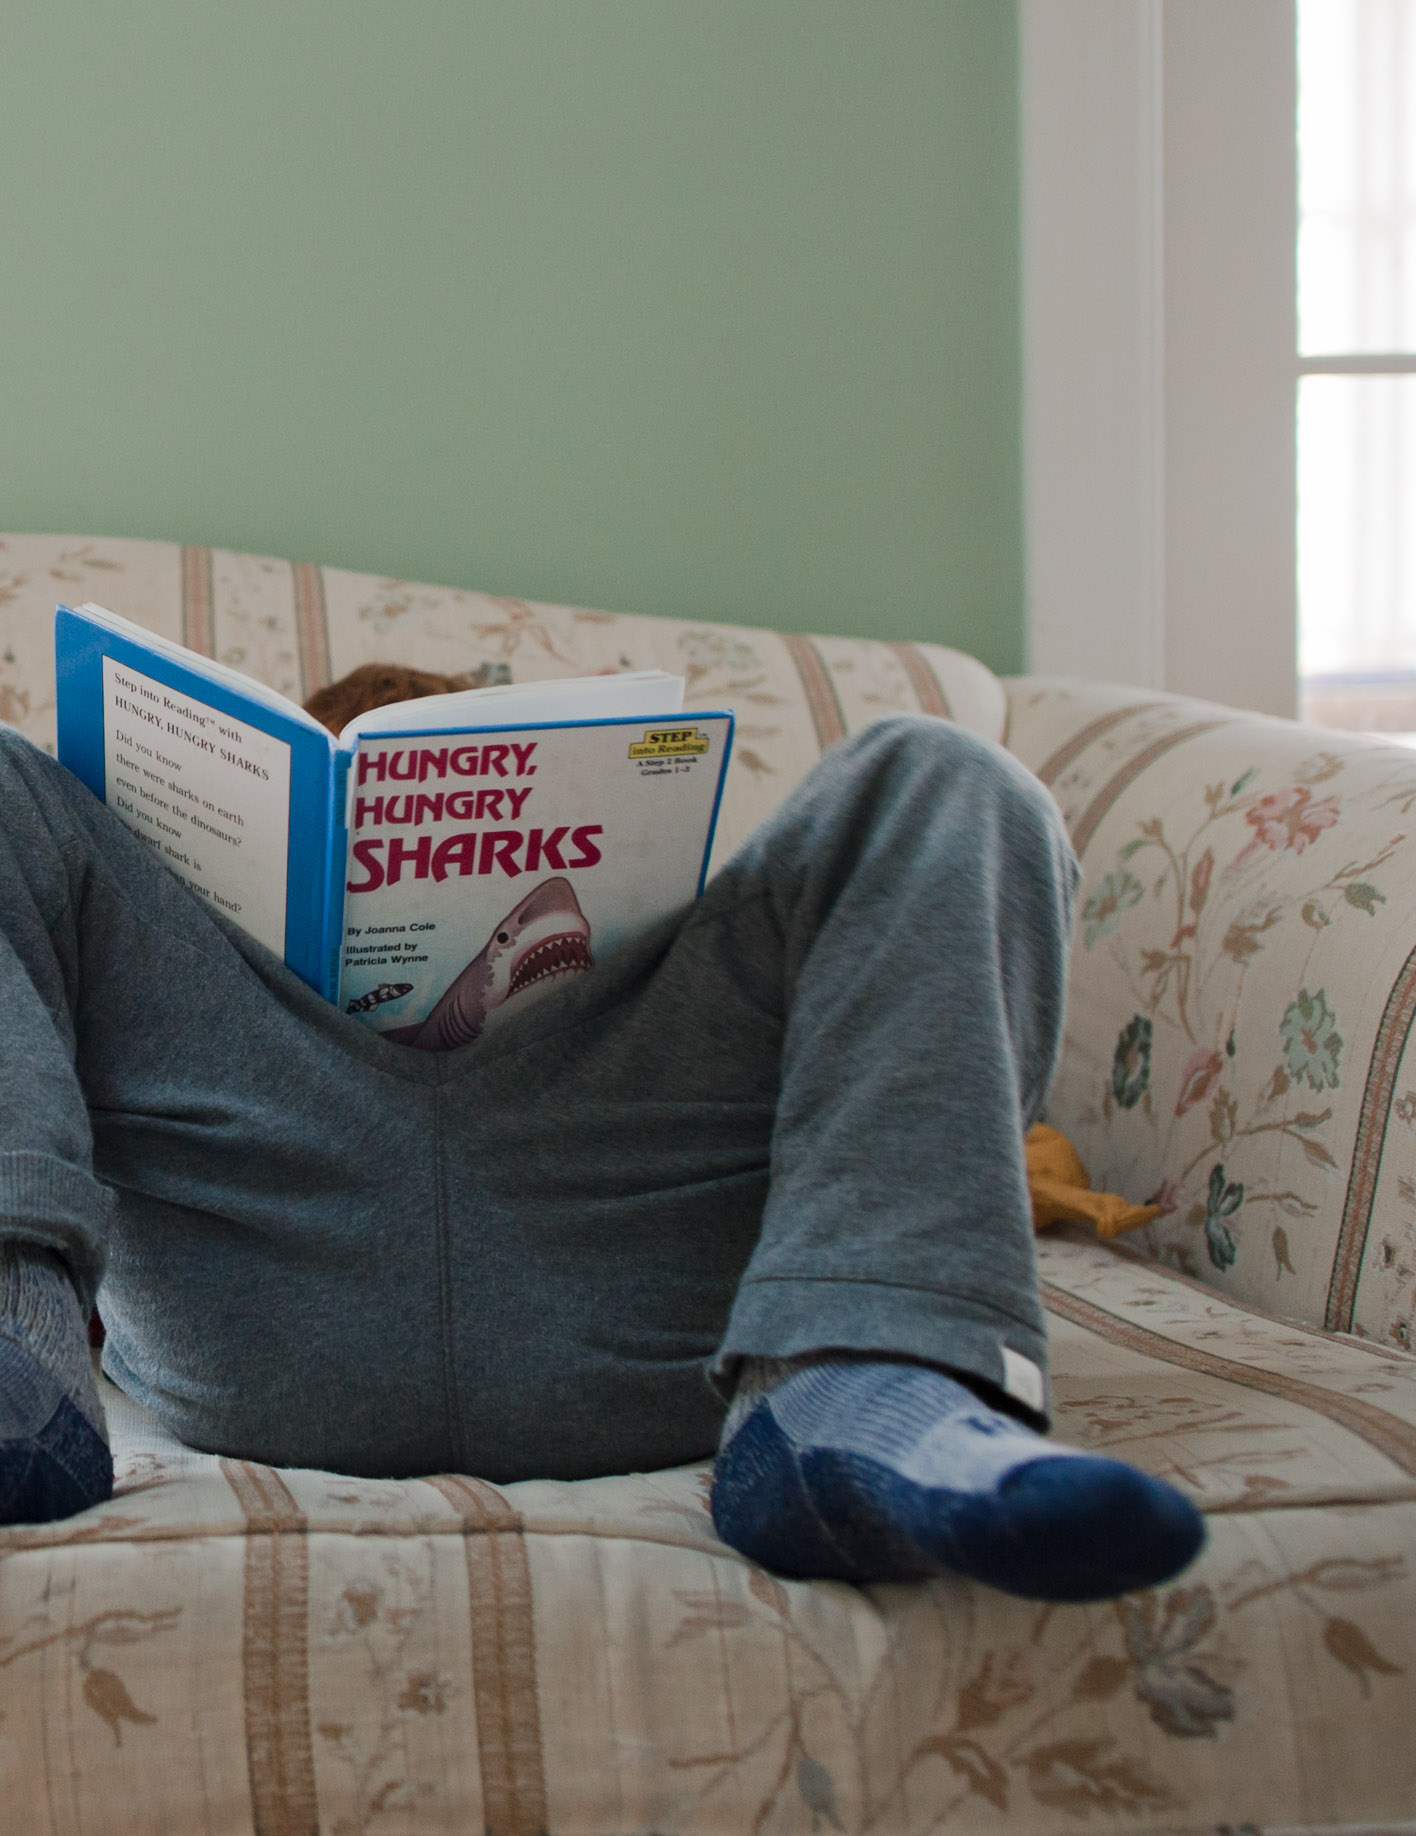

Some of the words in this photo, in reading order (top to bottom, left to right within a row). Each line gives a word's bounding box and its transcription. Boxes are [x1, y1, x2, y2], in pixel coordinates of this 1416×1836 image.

[115, 672, 138, 693] Step
[140, 685, 160, 703] into
[219, 725, 243, 744] with
[115, 695, 164, 731] HUNGRY,
[167, 722, 216, 754] HUNGRY
[220, 748, 270, 781] SHARKS
[116, 729, 133, 748] Did
[135, 741, 153, 757] you
[156, 750, 182, 772] know
[633, 747, 655, 755] into
[659, 744, 704, 754] Reading
[650, 731, 692, 743] STEP
[357, 742, 539, 787] HUNGRY,
[116, 753, 140, 773] there
[143, 768, 165, 786] were
[168, 780, 200, 804] sharks
[202, 800, 215, 812] on
[217, 807, 244, 827] earth
[355, 787, 534, 830] HUNGRY
[116, 777, 137, 794] even
[140, 786, 169, 810] before
[172, 804, 188, 820] the
[190, 815, 243, 848] dinosaurs?
[116, 796, 133, 813] Did
[136, 807, 153, 824] you
[156, 817, 182, 839] know
[133, 828, 162, 850] dwarf
[164, 845, 191, 866] shark
[193, 859, 202, 872] is
[346, 824, 604, 894] SHARKS
[189, 880, 211, 899] your
[213, 891, 243, 914] hand?
[346, 943, 401, 954] Illustrated
[404, 942, 418, 952] by
[347, 927, 362, 937] By
[365, 926, 406, 934] Joanna
[409, 922, 436, 932] Cole
[345, 957, 387, 967] Patricia
[391, 955, 428, 964] Wynne
